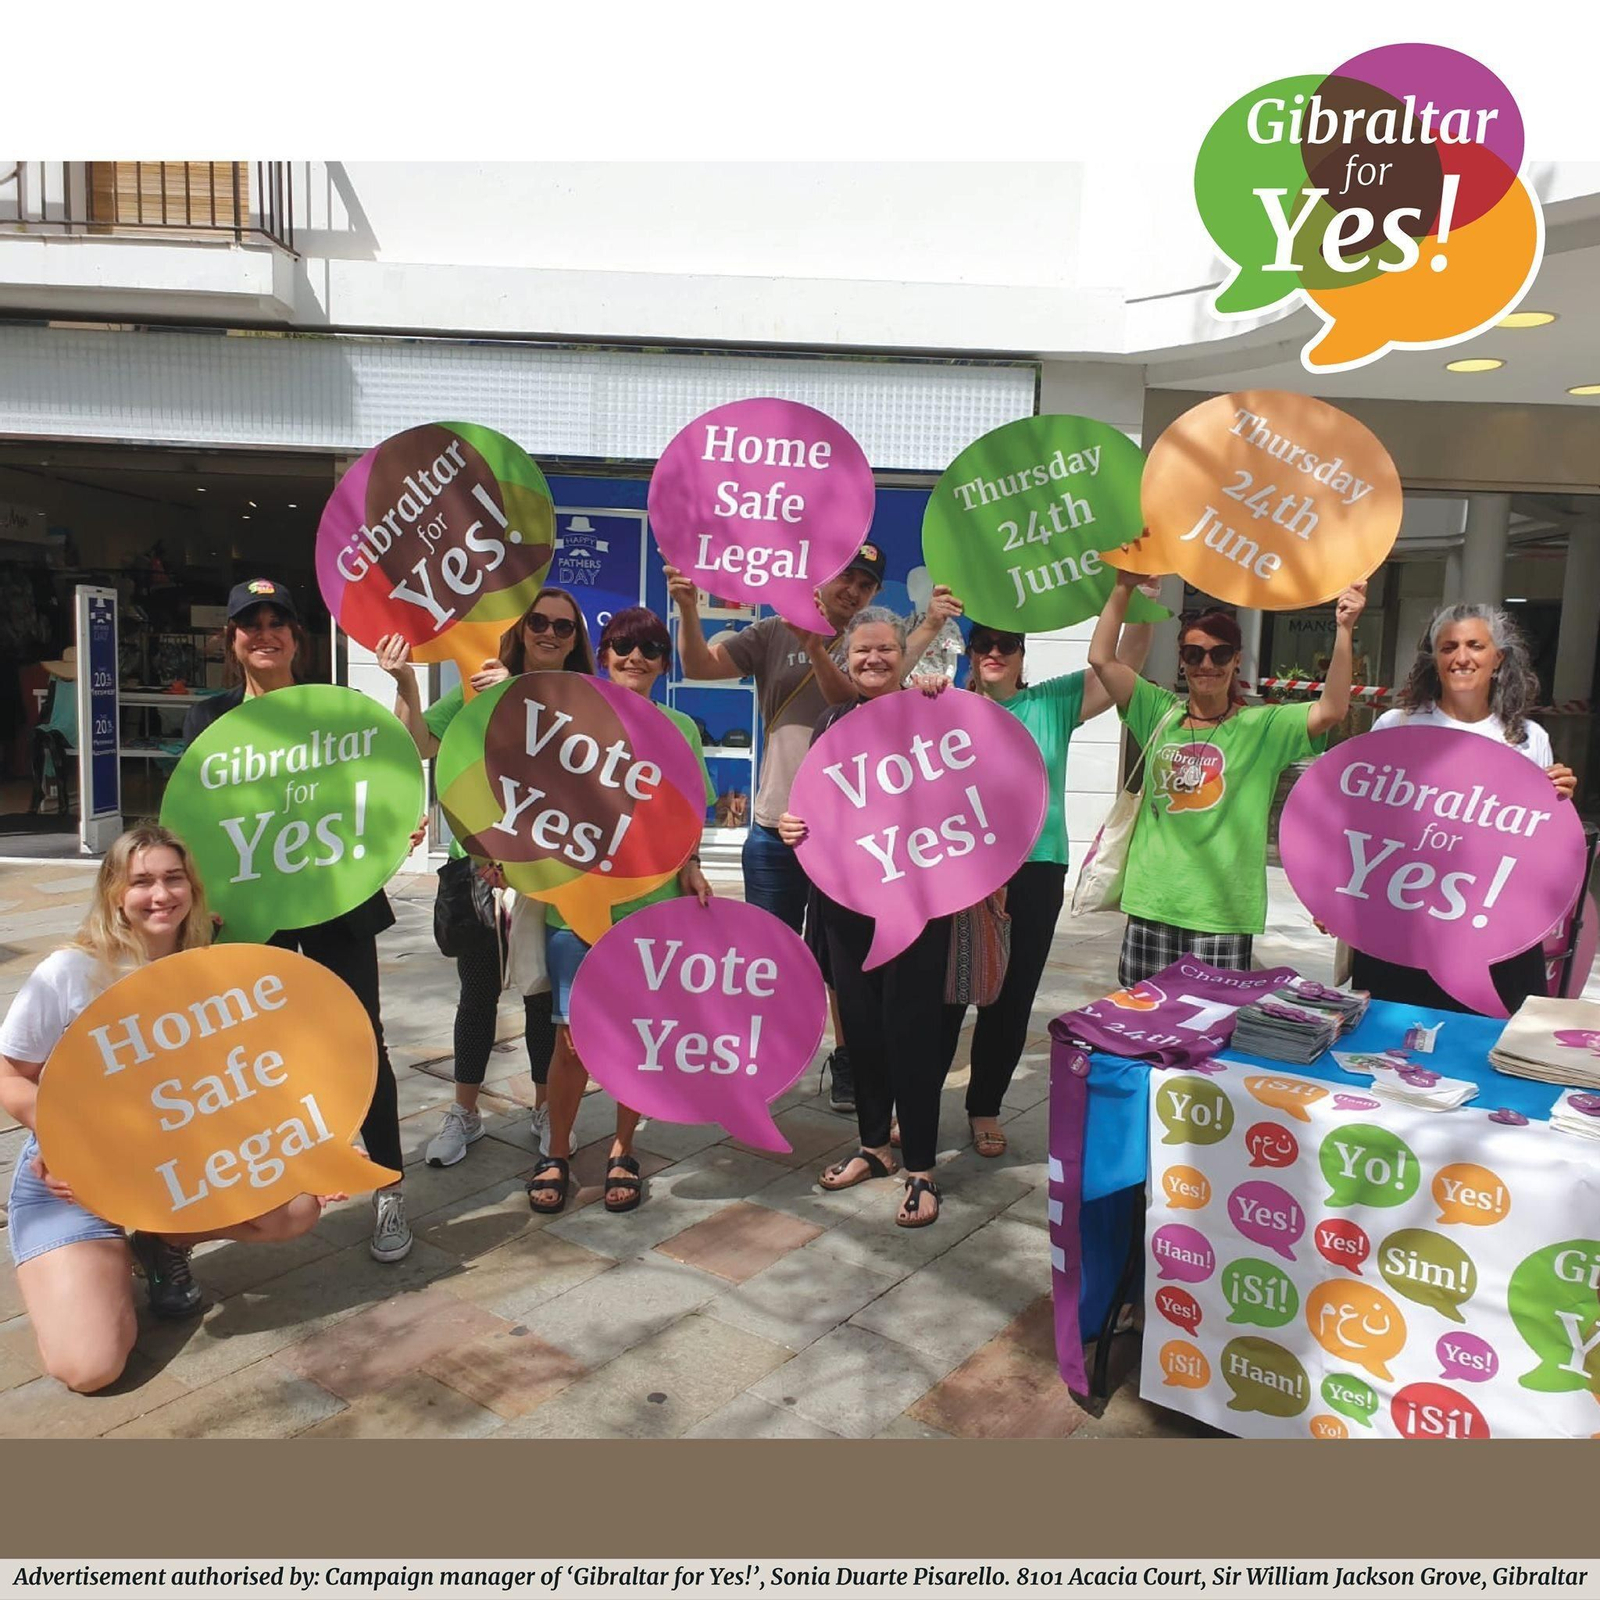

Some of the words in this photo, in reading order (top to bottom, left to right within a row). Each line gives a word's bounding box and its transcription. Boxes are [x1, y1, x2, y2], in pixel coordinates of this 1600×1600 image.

[701, 425, 832, 470] Home
[1228, 408, 1375, 506] Thursday
[954, 445, 1102, 512] Thursday
[336, 439, 469, 582] Gibraltar
[714, 481, 805, 523] Safe
[998, 493, 1096, 553] 24th
[1221, 471, 1320, 541] 24th
[416, 512, 449, 554] for
[565, 535, 597, 547] HAPPY
[1180, 506, 1284, 581] June
[388, 483, 523, 632] Yes!
[558, 558, 602, 569] FATHERS
[559, 568, 600, 586] DAY
[694, 534, 810, 587] Legal
[1007, 548, 1103, 609] June
[1289, 620, 1338, 632] MANG
[199, 727, 378, 790] Gibraltar
[524, 698, 662, 801] Vote
[823, 728, 976, 809] Vote
[282, 780, 319, 814] for
[1339, 762, 1551, 837] Gibraltar
[219, 780, 368, 884] Yes!
[492, 775, 632, 872] Yes!
[855, 785, 996, 883] Yes!
[1413, 822, 1463, 852] for
[1335, 828, 1517, 929] Yes!
[634, 938, 778, 997] Vote
[1180, 964, 1267, 989] Change
[88, 974, 288, 1076] Home
[632, 1015, 763, 1075] Yes!
[1102, 1022, 1182, 1045] 24th
[151, 1046, 288, 1132] Safe
[1167, 1090, 1223, 1130] Yo!
[155, 1093, 335, 1212] Legal
[1334, 1141, 1406, 1190] Yo!
[1168, 1175, 1206, 1200] Yes!
[1440, 1177, 1503, 1213] Yes!
[1235, 1195, 1298, 1234] Yes!
[1156, 1237, 1211, 1268] Haan!
[1320, 1230, 1364, 1256] Yes!
[1232, 1272, 1288, 1313] ¡Sí!
[1385, 1247, 1469, 1293] Sim!
[1160, 1295, 1197, 1320] Yes!
[1169, 1351, 1201, 1378] ¡Sí!
[1229, 1353, 1303, 1399] Haan!
[1443, 1342, 1492, 1373] Yes!
[1327, 1382, 1372, 1409] Yes!
[1317, 1423, 1342, 1438] Yo!
